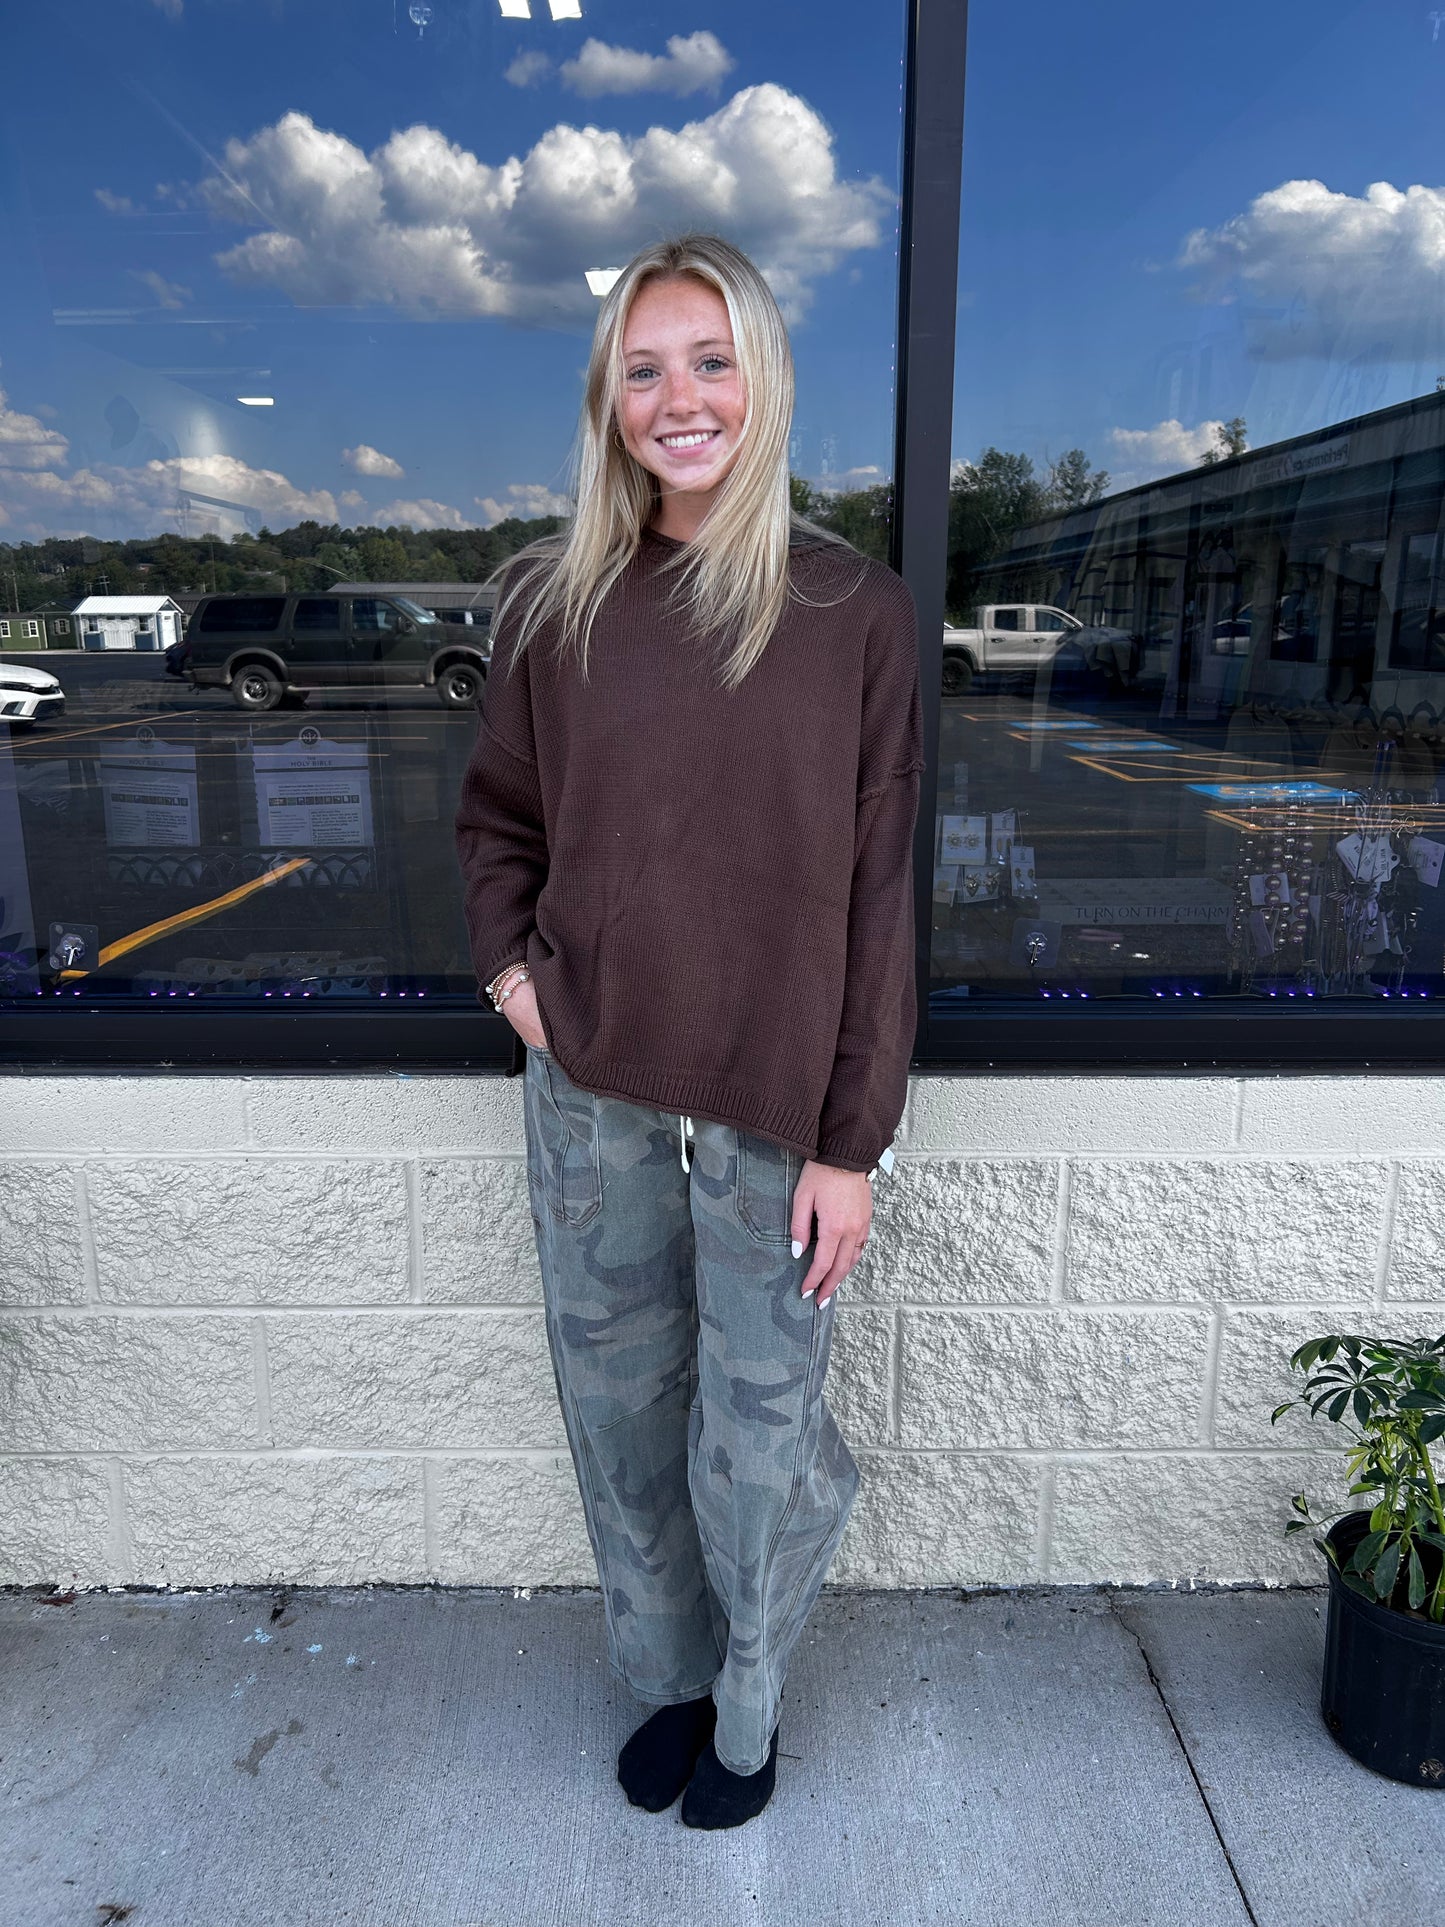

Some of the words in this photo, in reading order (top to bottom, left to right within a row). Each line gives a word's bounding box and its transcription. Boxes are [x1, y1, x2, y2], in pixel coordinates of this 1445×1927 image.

[1075, 906, 1115, 919] TURN
[1119, 906, 1140, 918] ON
[1145, 906, 1172, 918] THE
[1176, 905, 1230, 920] CHARM
